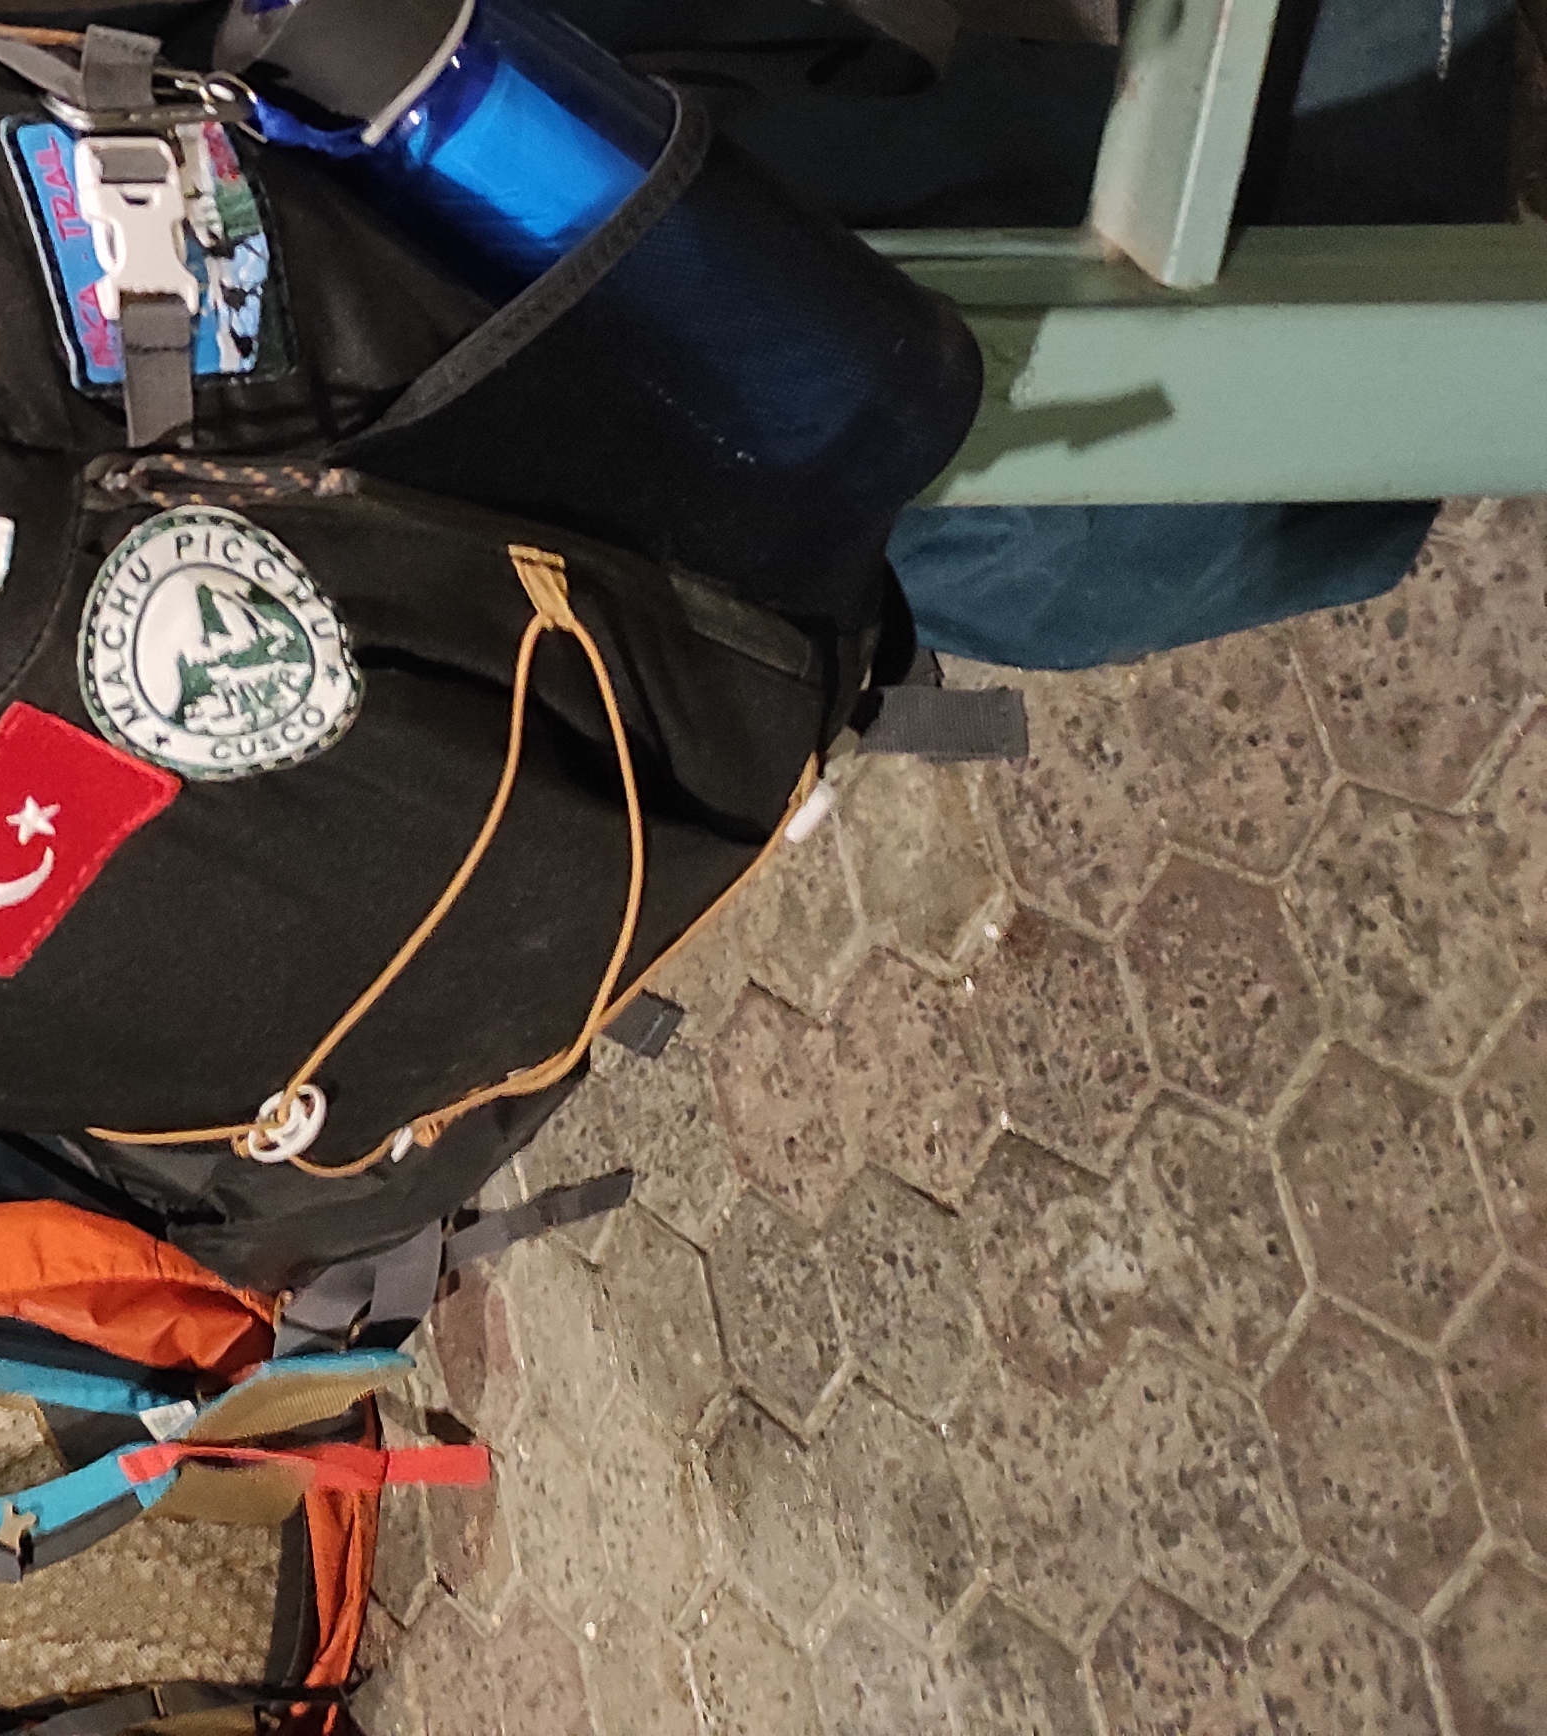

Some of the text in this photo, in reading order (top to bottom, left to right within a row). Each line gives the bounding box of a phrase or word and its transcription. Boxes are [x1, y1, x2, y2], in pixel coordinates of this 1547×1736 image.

[34, 136, 88, 243] TRAIL
[101, 530, 337, 728] MACHU PICCHU
